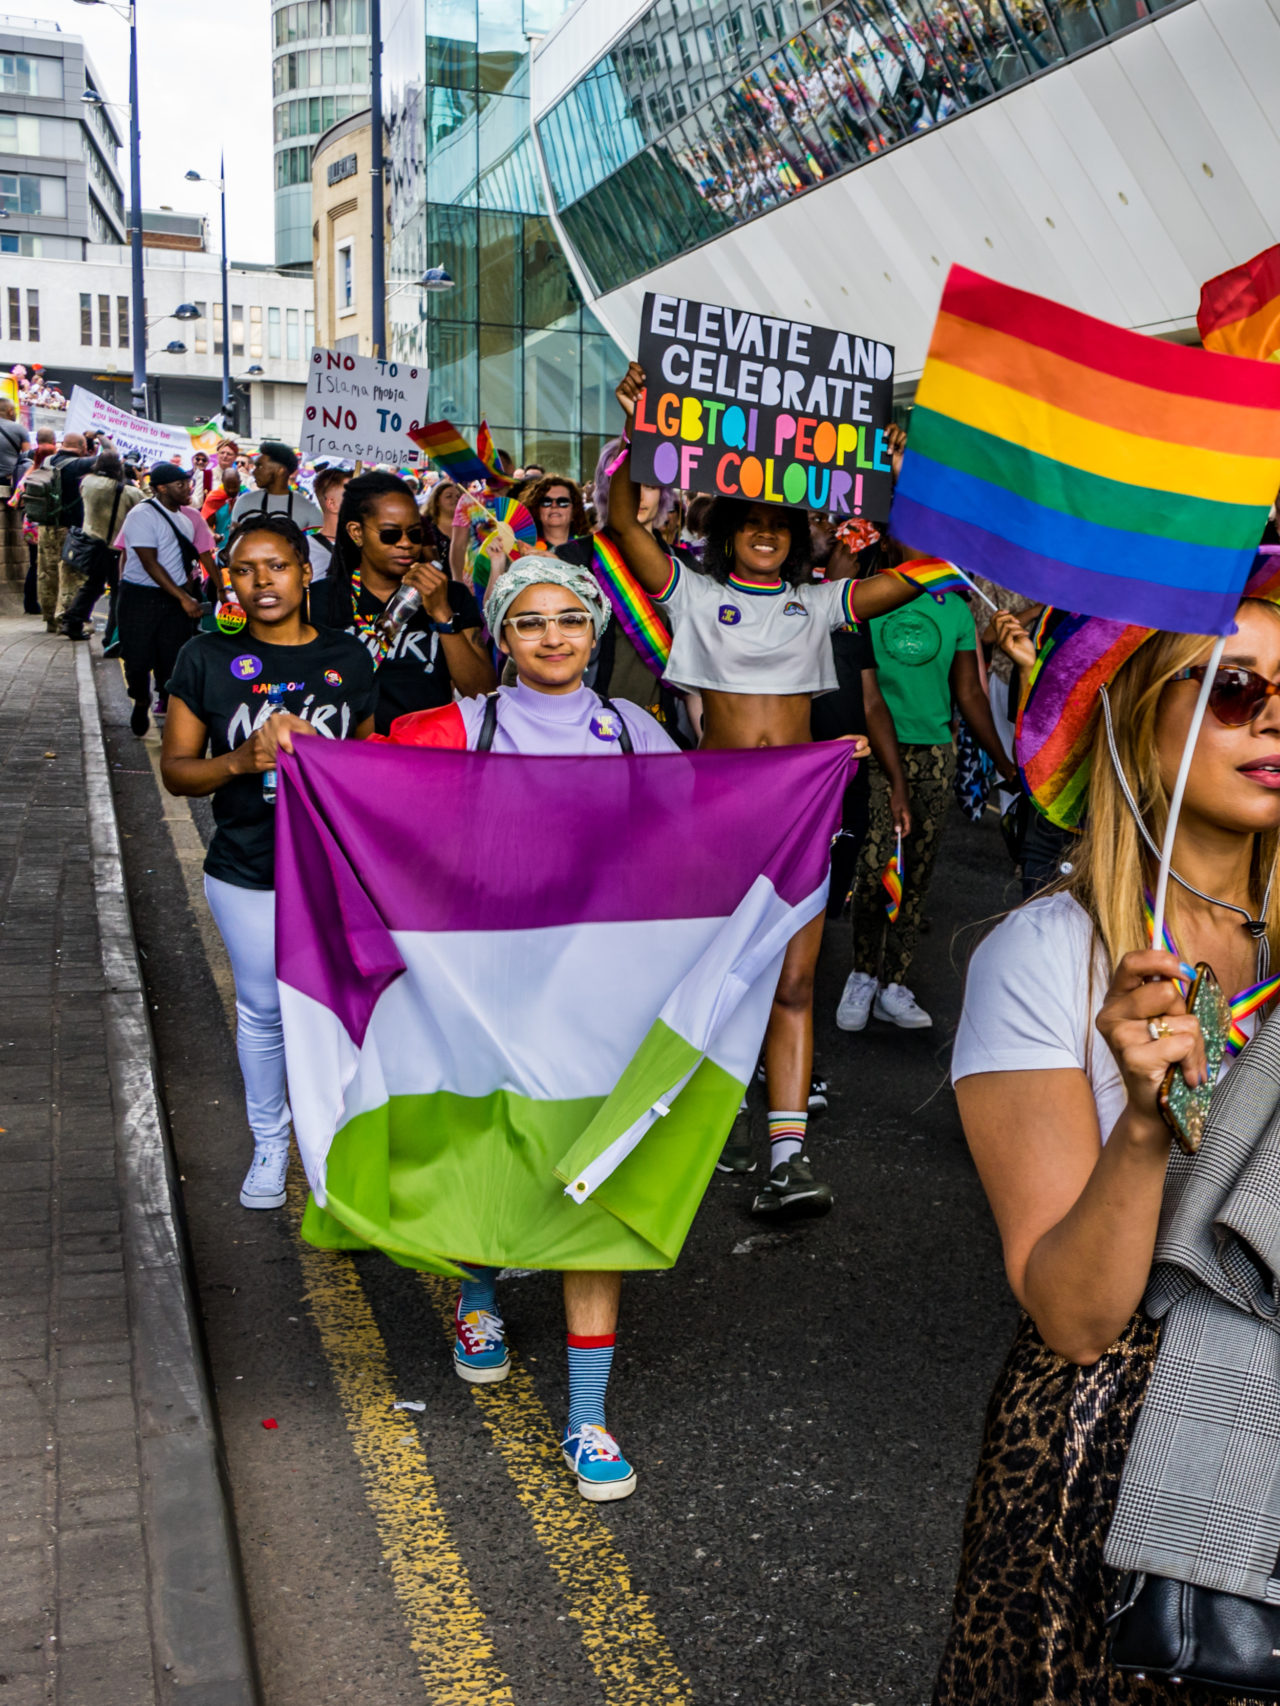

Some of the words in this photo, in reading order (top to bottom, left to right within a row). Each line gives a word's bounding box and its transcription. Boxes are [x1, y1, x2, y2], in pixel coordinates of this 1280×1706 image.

[327, 350, 356, 371] NO
[377, 360, 398, 378] TO
[650, 293, 812, 365] ELEVATE
[828, 332, 893, 381] AND
[322, 405, 357, 431] NO
[376, 408, 402, 433] TO
[661, 344, 873, 423] CELEBRATE
[634, 387, 759, 452] LGBTQI
[774, 413, 892, 473] PEOPLE
[653, 441, 703, 490] OF
[715, 452, 864, 516] COLOUR!
[252, 681, 305, 694] RAIBOW
